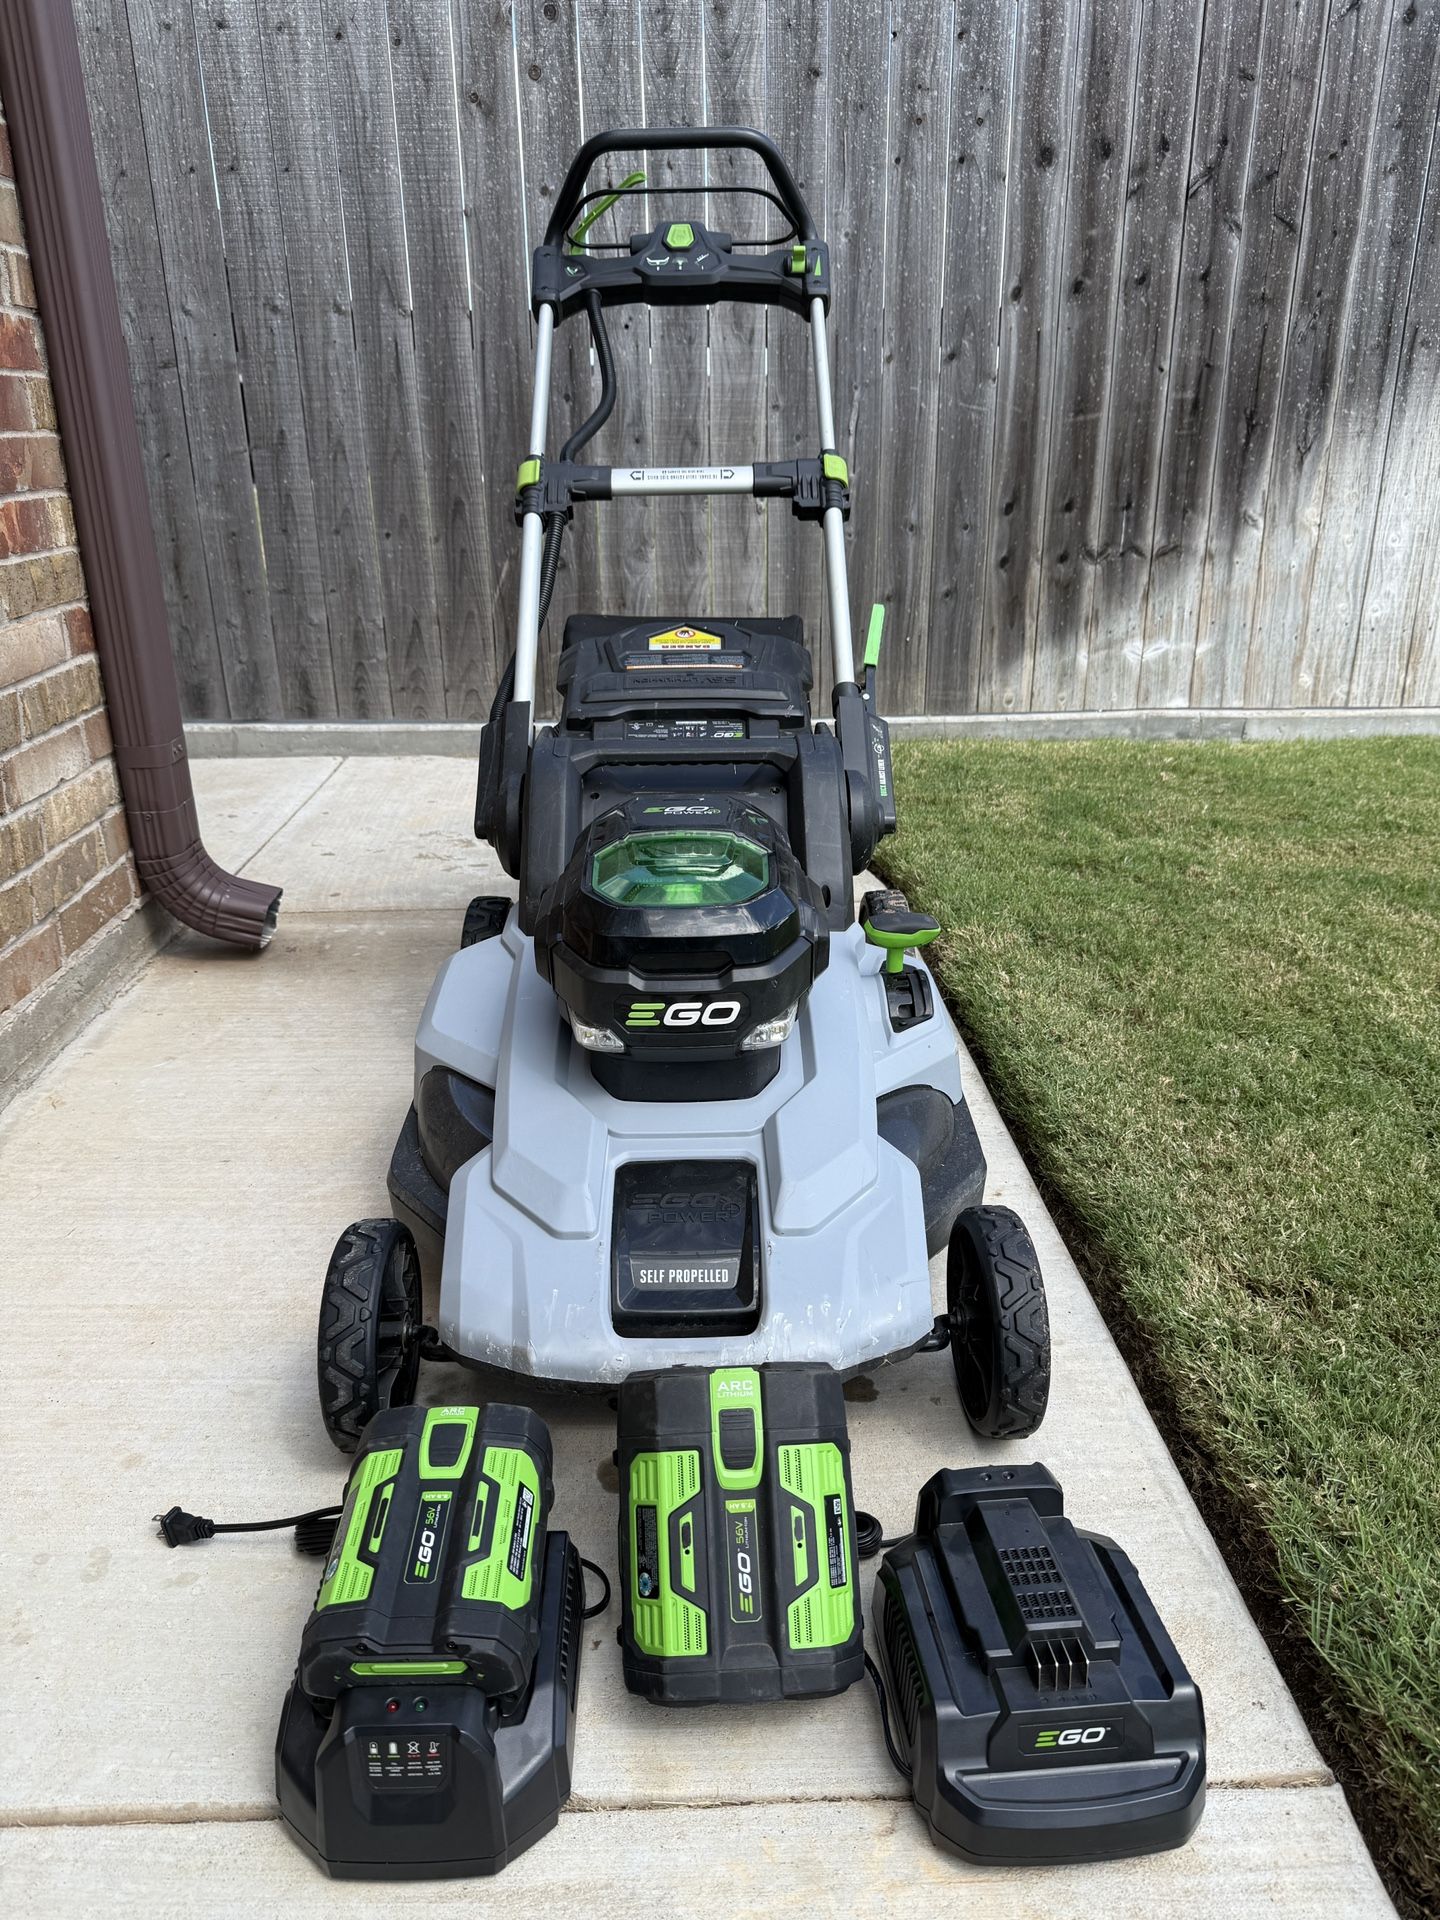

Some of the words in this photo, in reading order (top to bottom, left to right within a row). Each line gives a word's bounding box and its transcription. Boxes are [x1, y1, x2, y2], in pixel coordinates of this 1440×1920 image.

[642, 805, 710, 813] EGO
[625, 1001, 741, 1027] EGO
[626, 1192, 721, 1210] EGO
[639, 1269, 665, 1284] SELF
[668, 1268, 729, 1283] PROPELLED
[717, 1379, 753, 1391] ARC
[414, 1531, 436, 1578] EGO
[425, 1506, 436, 1526] 56V
[735, 1520, 745, 1544] 56V
[738, 1552, 754, 1614] EGO
[1034, 1727, 1106, 1748] EGO
